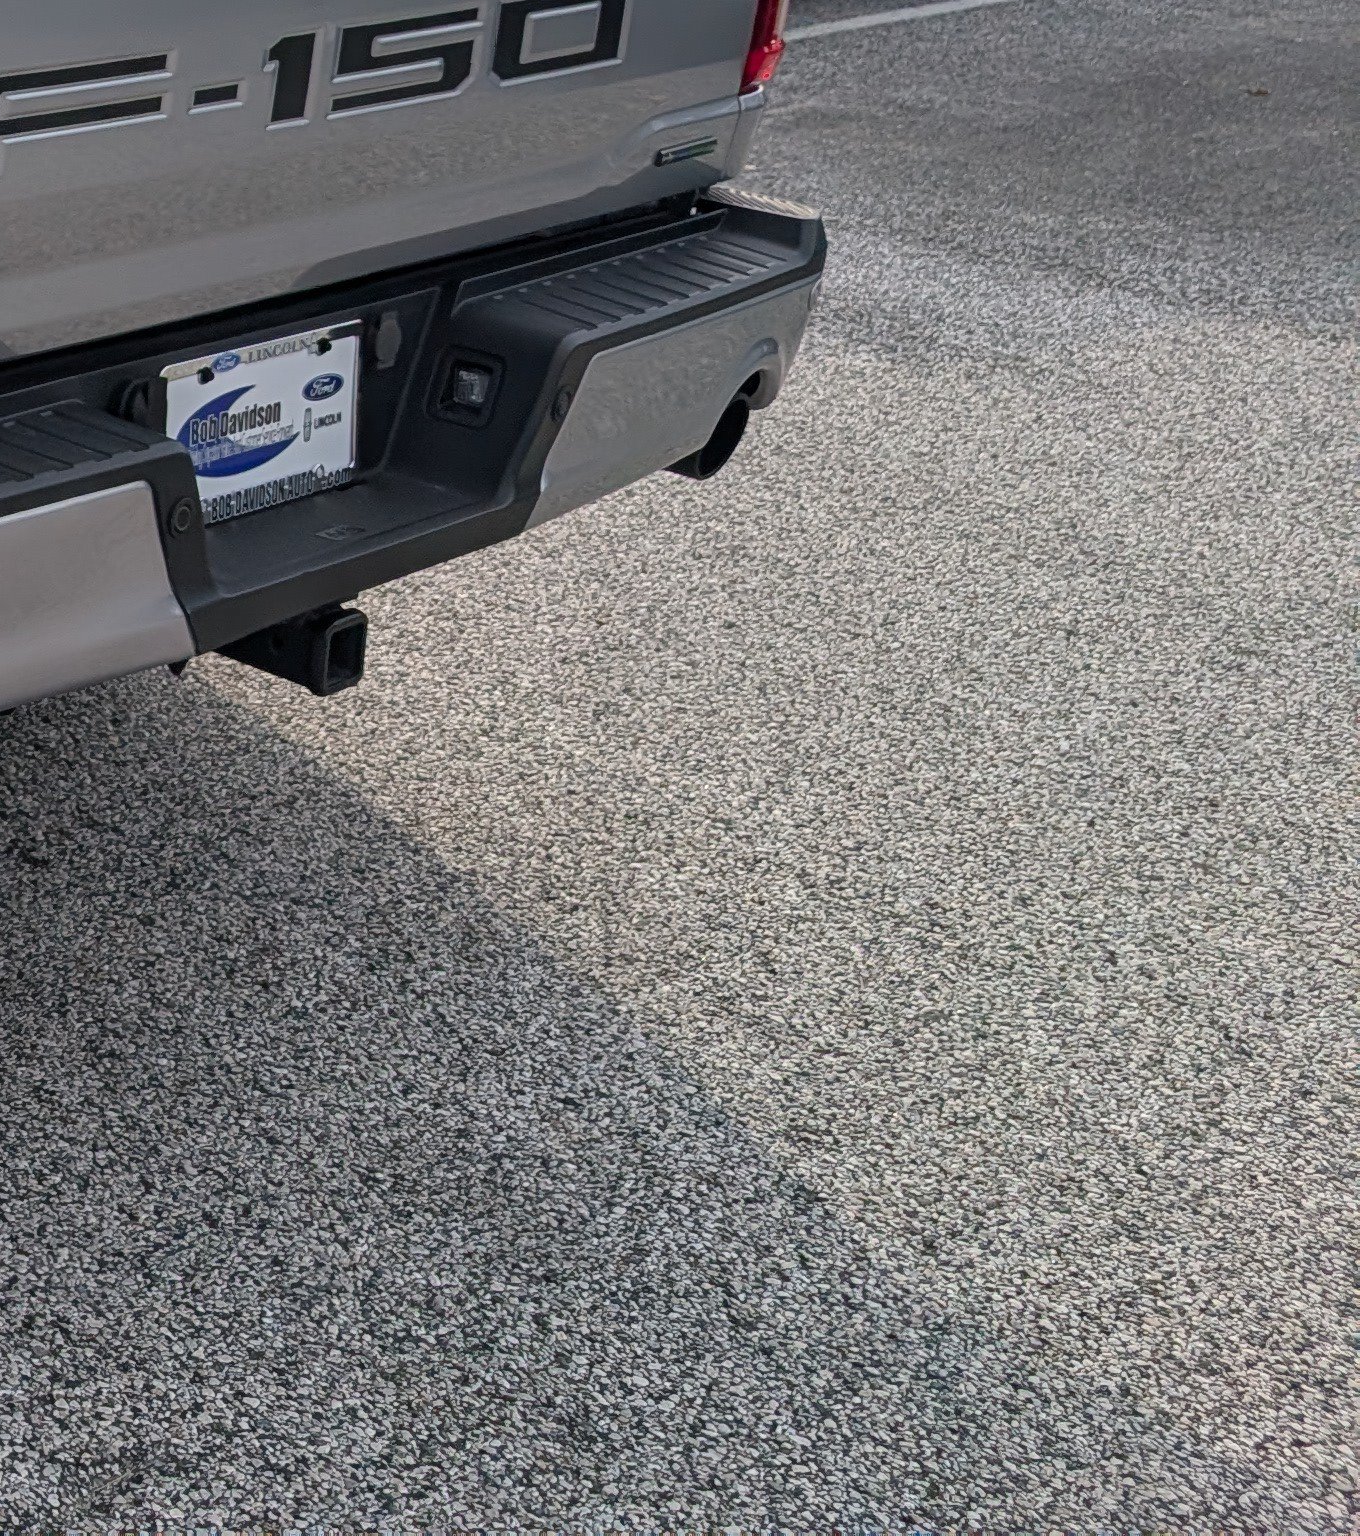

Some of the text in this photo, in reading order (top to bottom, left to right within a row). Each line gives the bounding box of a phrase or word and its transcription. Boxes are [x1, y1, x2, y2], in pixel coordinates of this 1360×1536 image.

[190, 417, 219, 446] Bob
[219, 401, 282, 438] Davidson
[314, 412, 342, 429] LINCOLN
